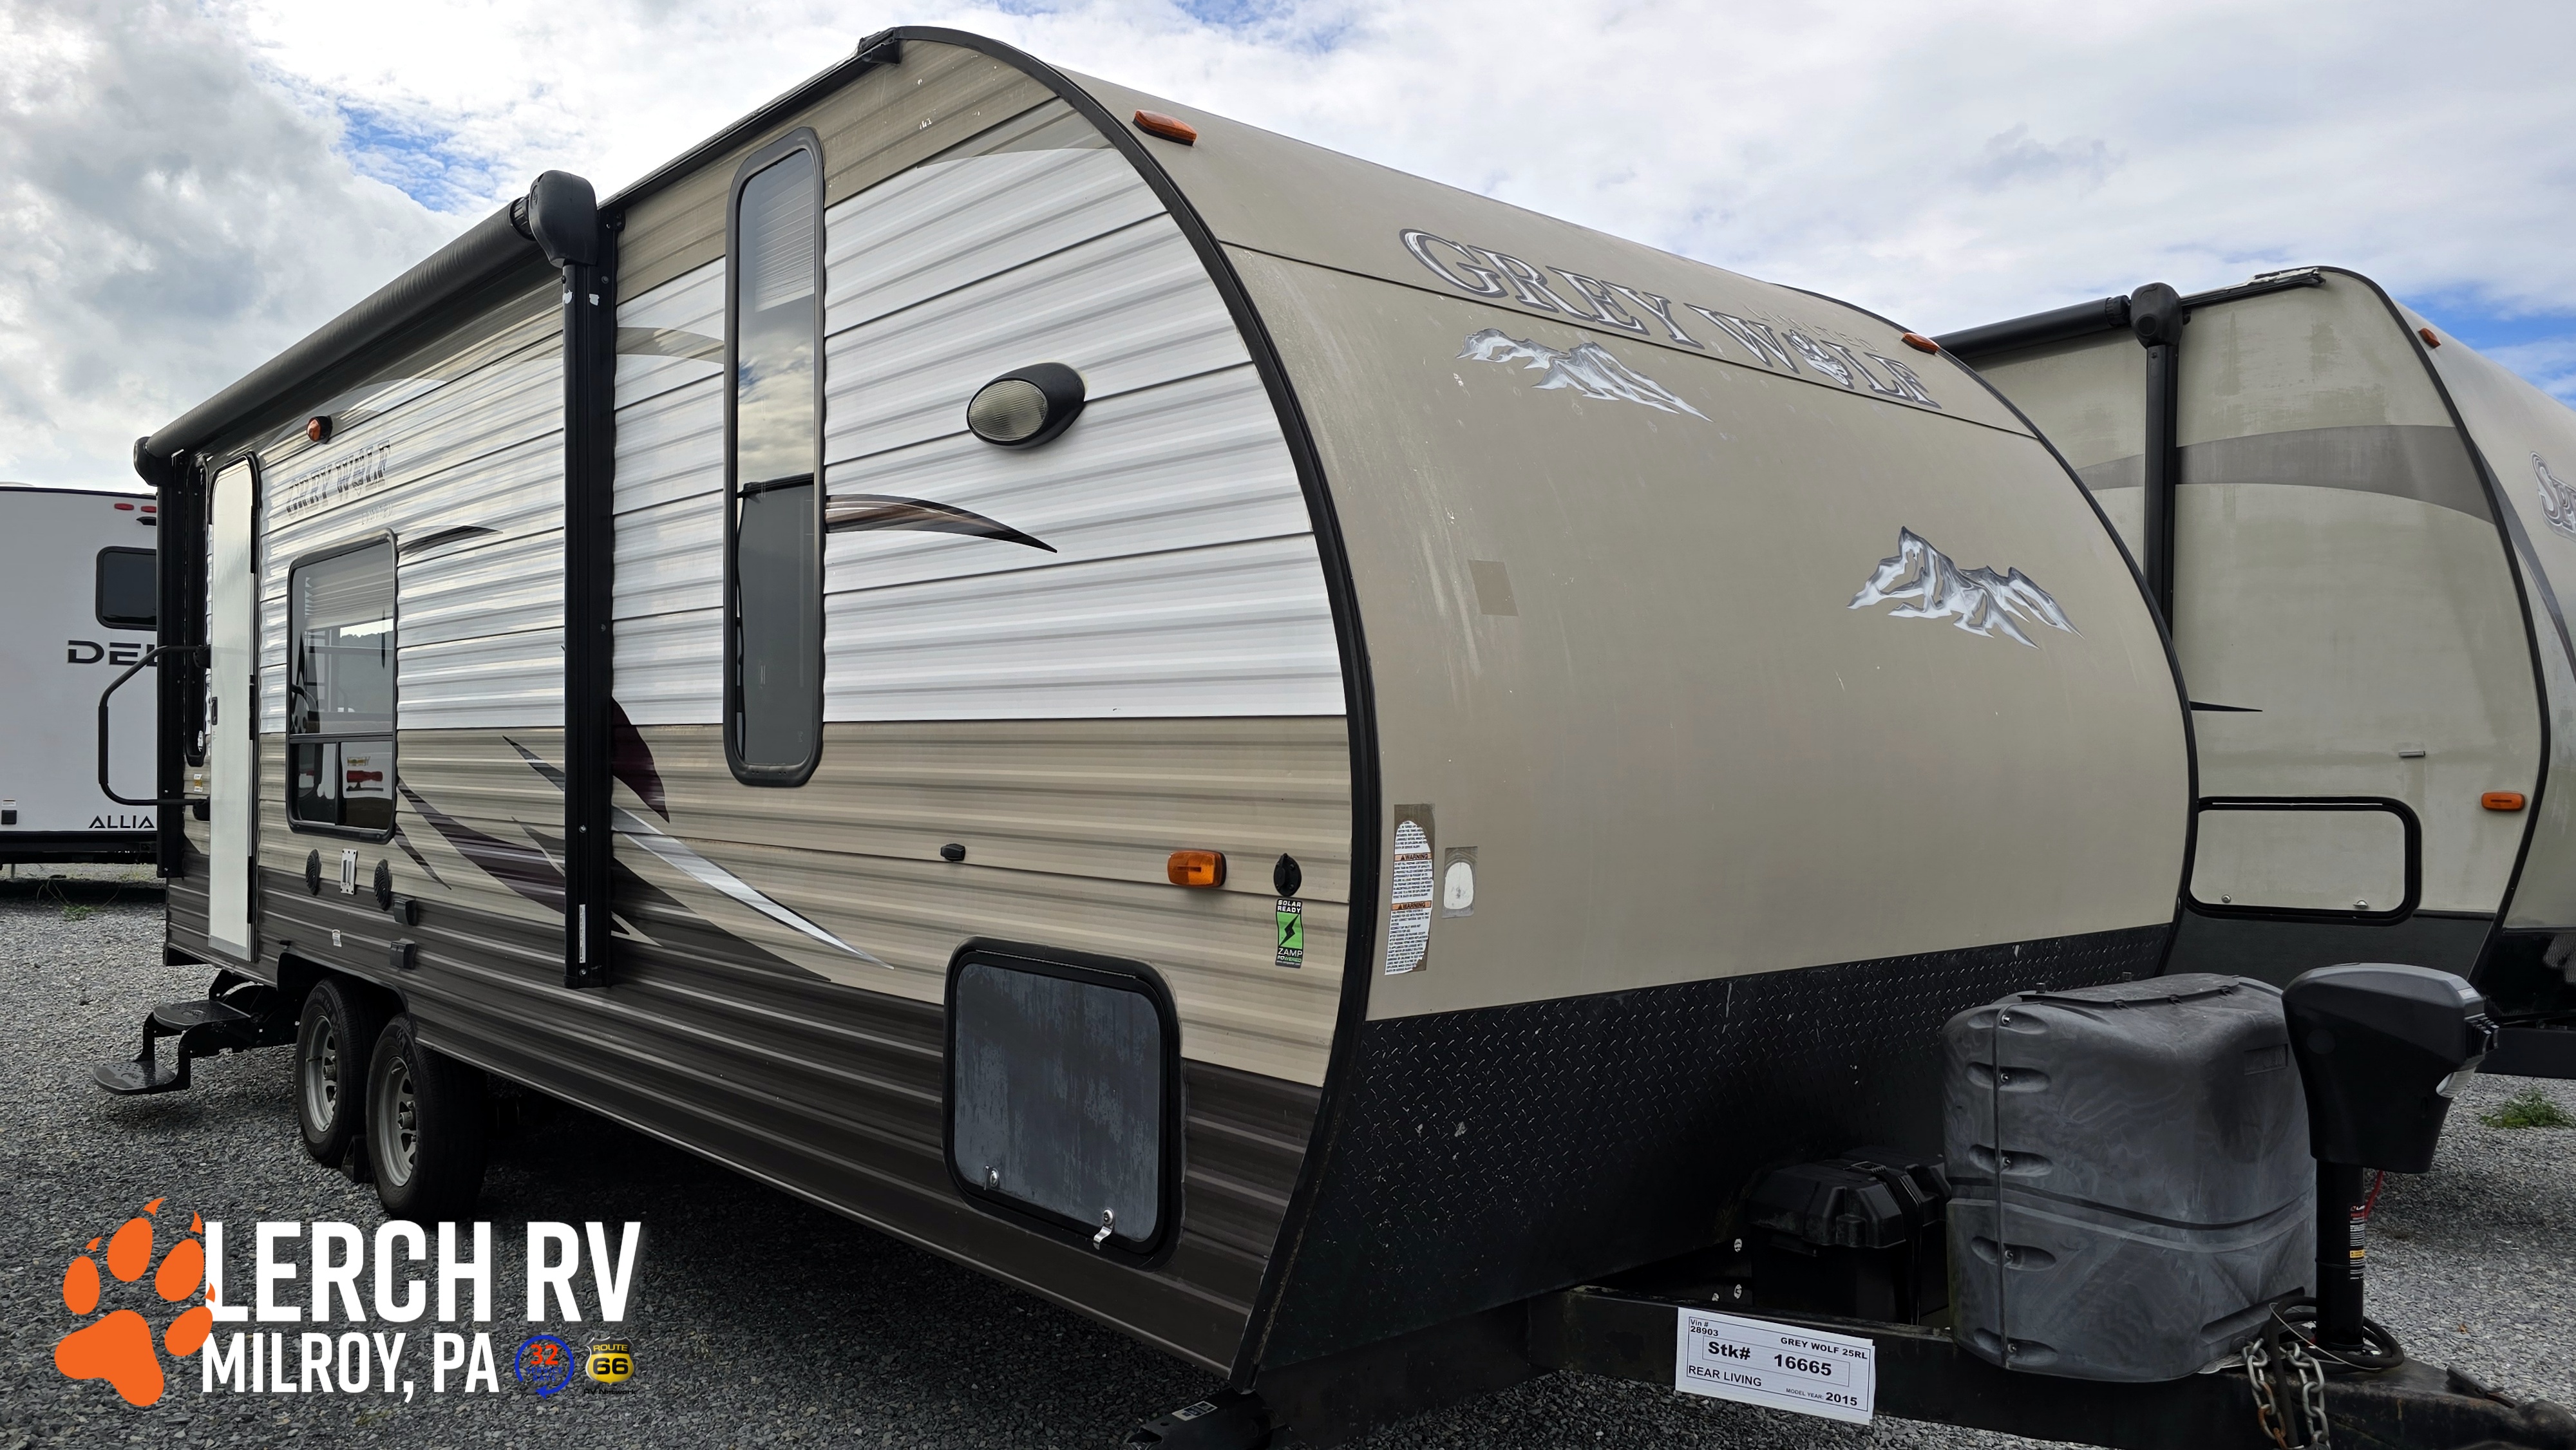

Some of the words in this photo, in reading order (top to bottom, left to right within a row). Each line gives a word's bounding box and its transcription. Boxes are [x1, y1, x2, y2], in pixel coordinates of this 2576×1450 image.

[1399, 229, 1705, 350] GREY
[287, 464, 332, 519] GREY
[2530, 451, 2576, 534] SP
[1278, 948, 1303, 957] ZAMP
[1690, 1325, 1719, 1337] 28903
[1708, 1341, 1751, 1361] Stk#
[1774, 1353, 1832, 1377] 16665
[1781, 1337, 1808, 1348] GREY
[1811, 1342, 1840, 1353] WOLF
[1842, 1348, 1868, 1360] 25RL
[1689, 1365, 1720, 1379] REAR
[1724, 1371, 1762, 1387] LIVING
[1786, 1388, 1806, 1397] MODEL
[1826, 1391, 1858, 1406] 2015
